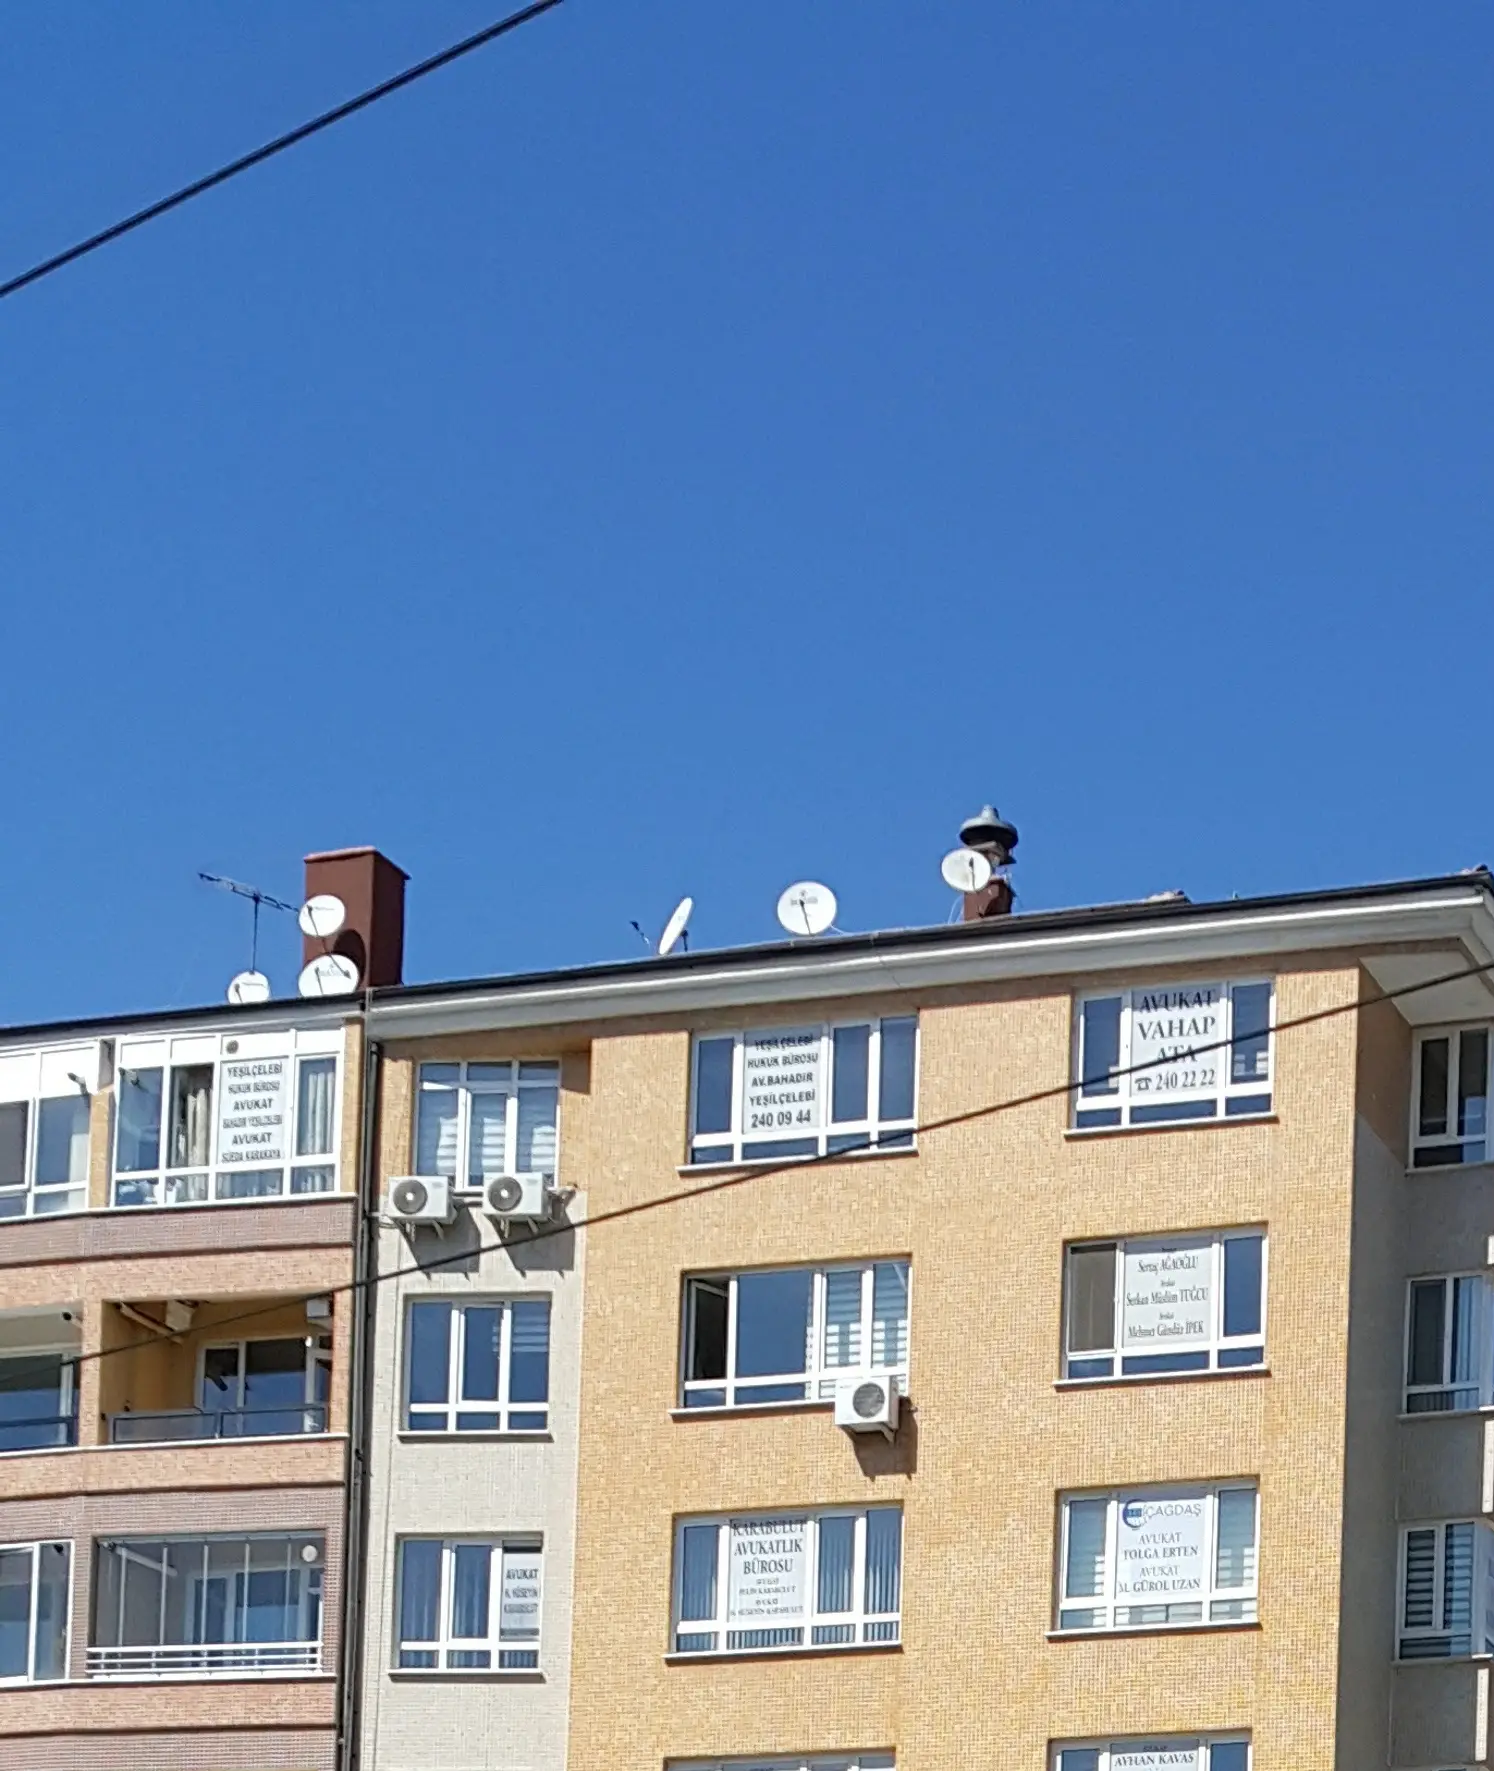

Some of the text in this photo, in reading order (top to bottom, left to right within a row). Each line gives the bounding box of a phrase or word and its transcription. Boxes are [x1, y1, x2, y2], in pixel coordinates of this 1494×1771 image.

[1140, 988, 1215, 1013] AVUKAT
[1137, 1016, 1216, 1041] VAHAP
[748, 1056, 780, 1069] HUKUK
[1156, 1068, 1215, 1091] 240 22 22
[233, 1098, 274, 1112] AVUKAT
[751, 1108, 812, 1129] 240 09 44
[232, 1132, 272, 1146] AVUKAT
[734, 1538, 804, 1556] AVUKATLIK
[1139, 1532, 1182, 1545] AVUKAT
[743, 1557, 794, 1575] BÜROSU
[1139, 1565, 1181, 1578] AVUKAT
